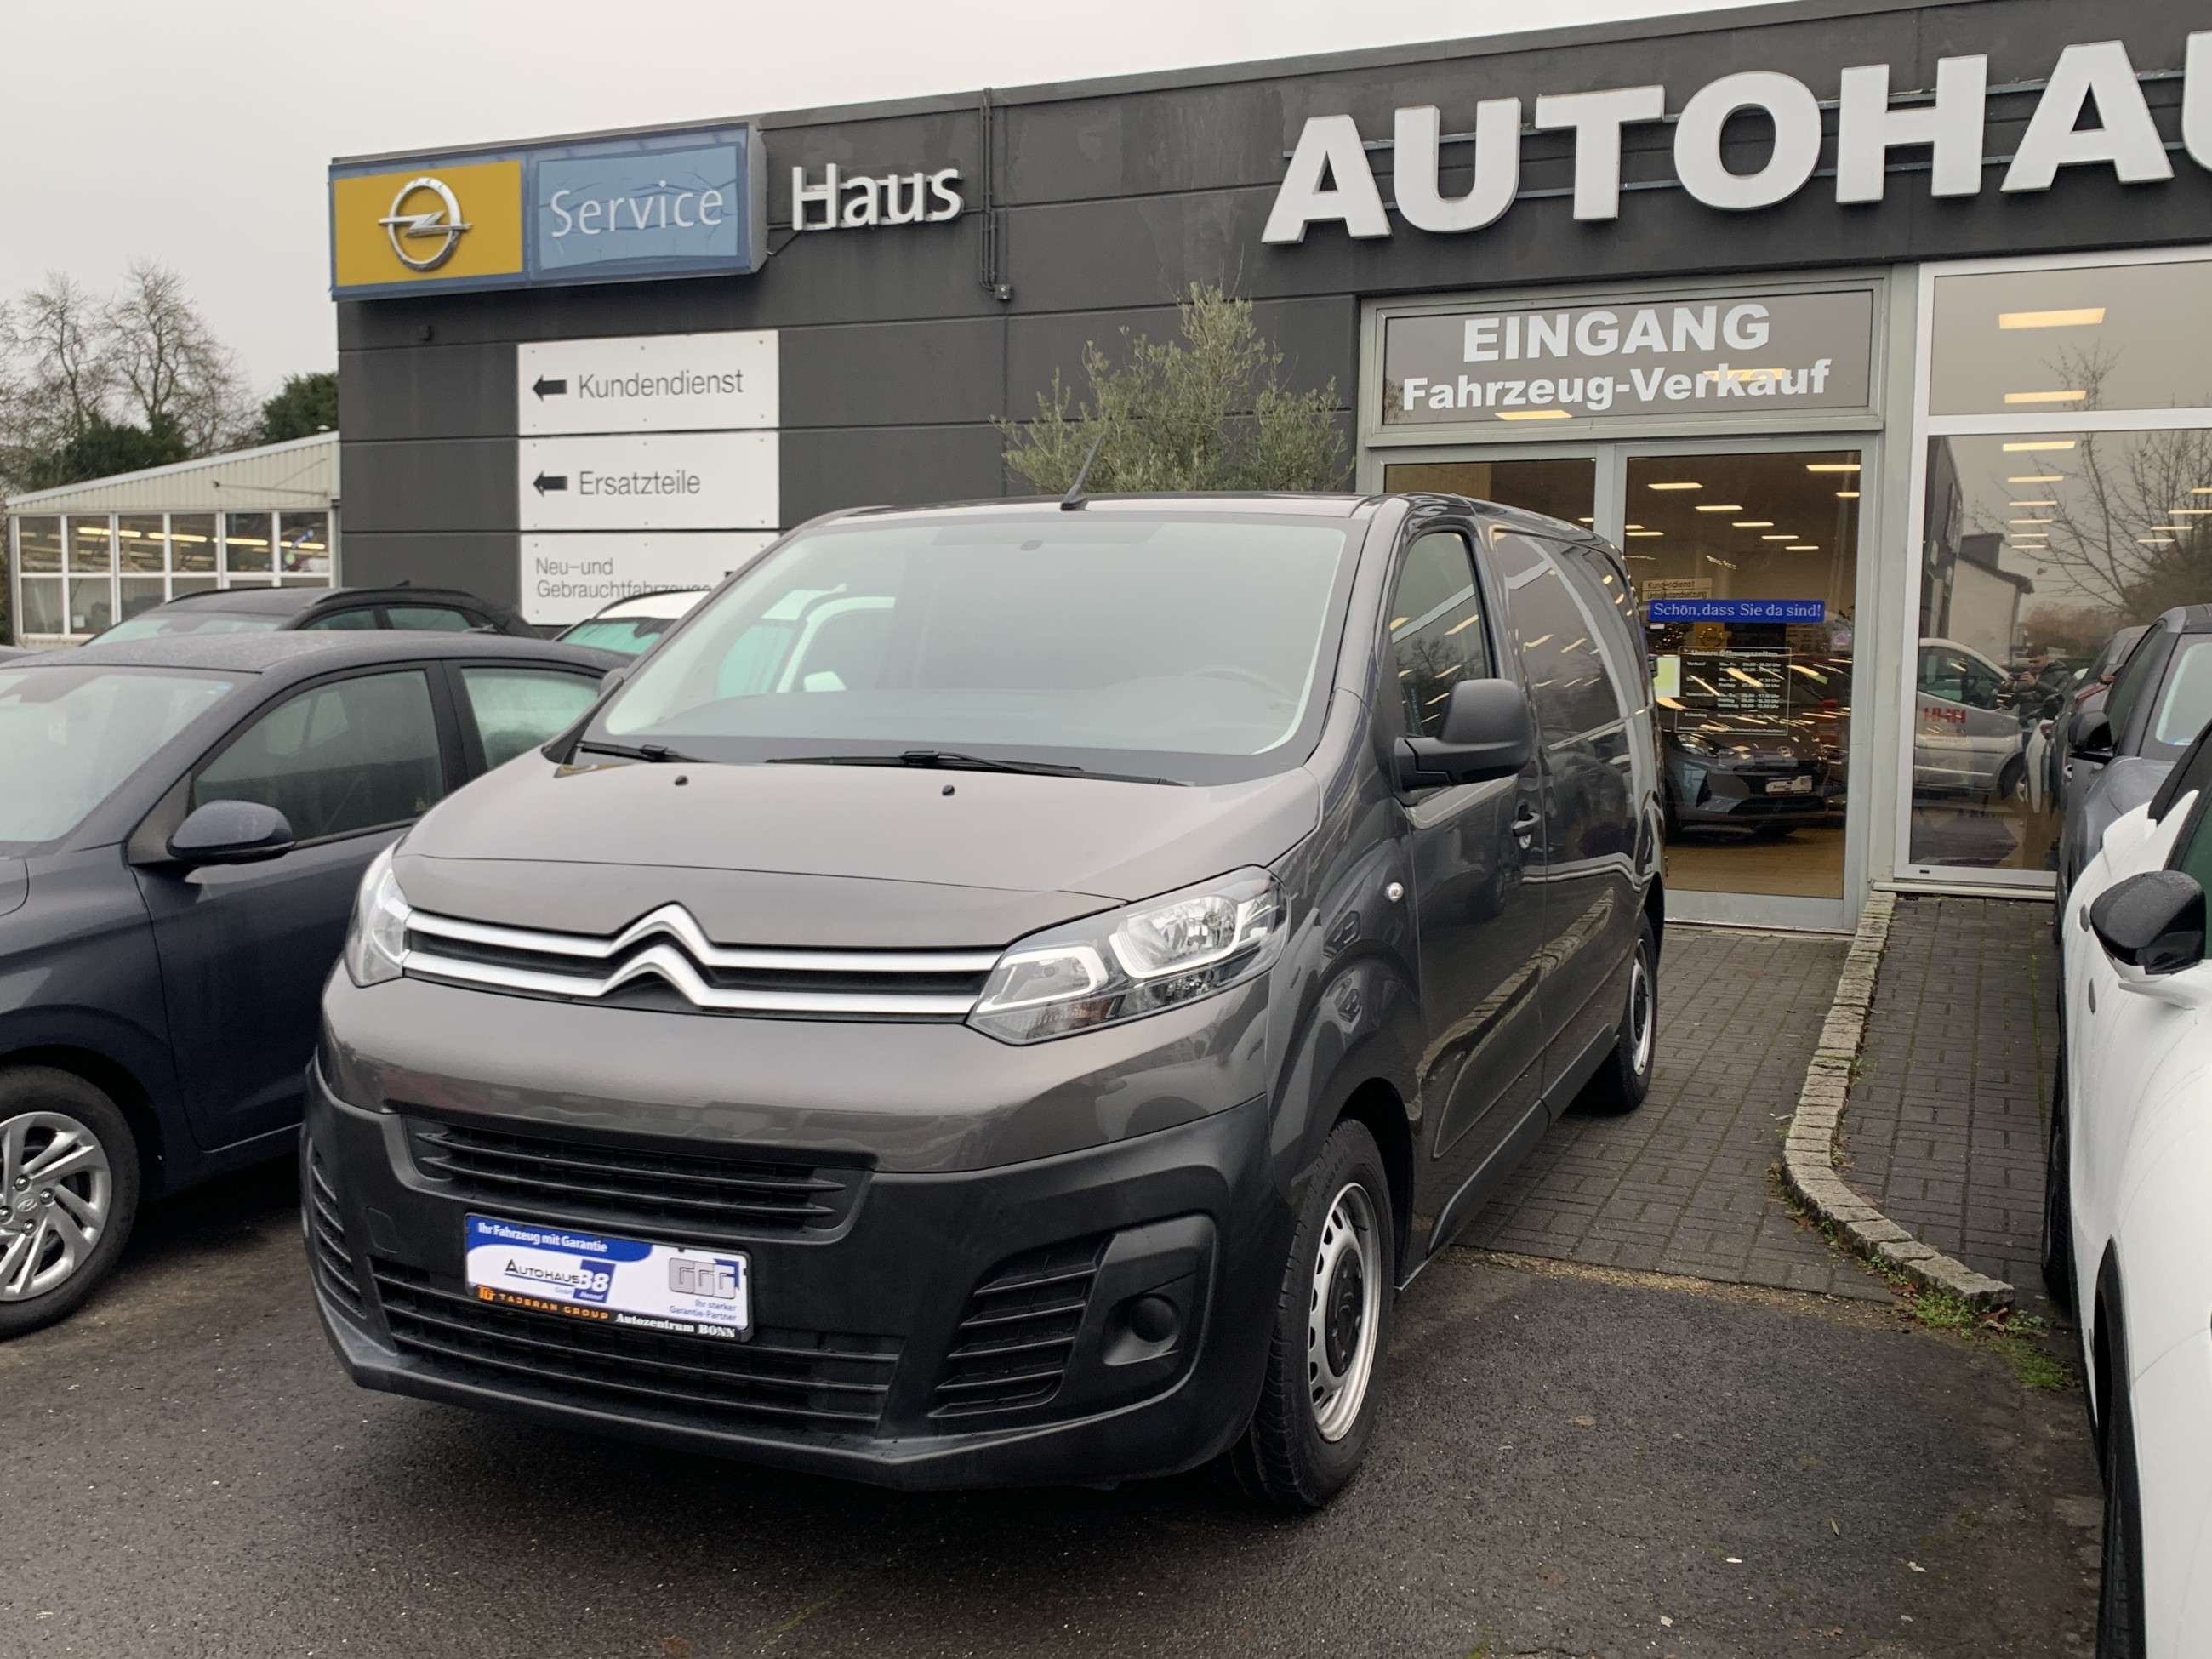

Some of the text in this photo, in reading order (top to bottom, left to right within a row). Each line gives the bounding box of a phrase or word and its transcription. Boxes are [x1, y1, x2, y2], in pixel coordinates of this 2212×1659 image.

[1261, 30, 2212, 244] AUTOHA
[550, 180, 723, 237] Service
[791, 162, 966, 231] Haus
[1462, 304, 1770, 362] EINGANG
[579, 369, 744, 398] Kundendienst
[1402, 359, 1833, 411] Fahrzeug-Verkauf
[579, 469, 701, 495] Ersatzteile
[1740, 603, 1763, 617] Sie
[1766, 603, 1783, 617] da
[1787, 604, 1821, 617] sind!
[478, 1223, 608, 1252] Ihr Fahrzeug mit Garantie
[562, 1306, 609, 1320] GROUP
[616, 1313, 736, 1338] Autozentrum BONN
